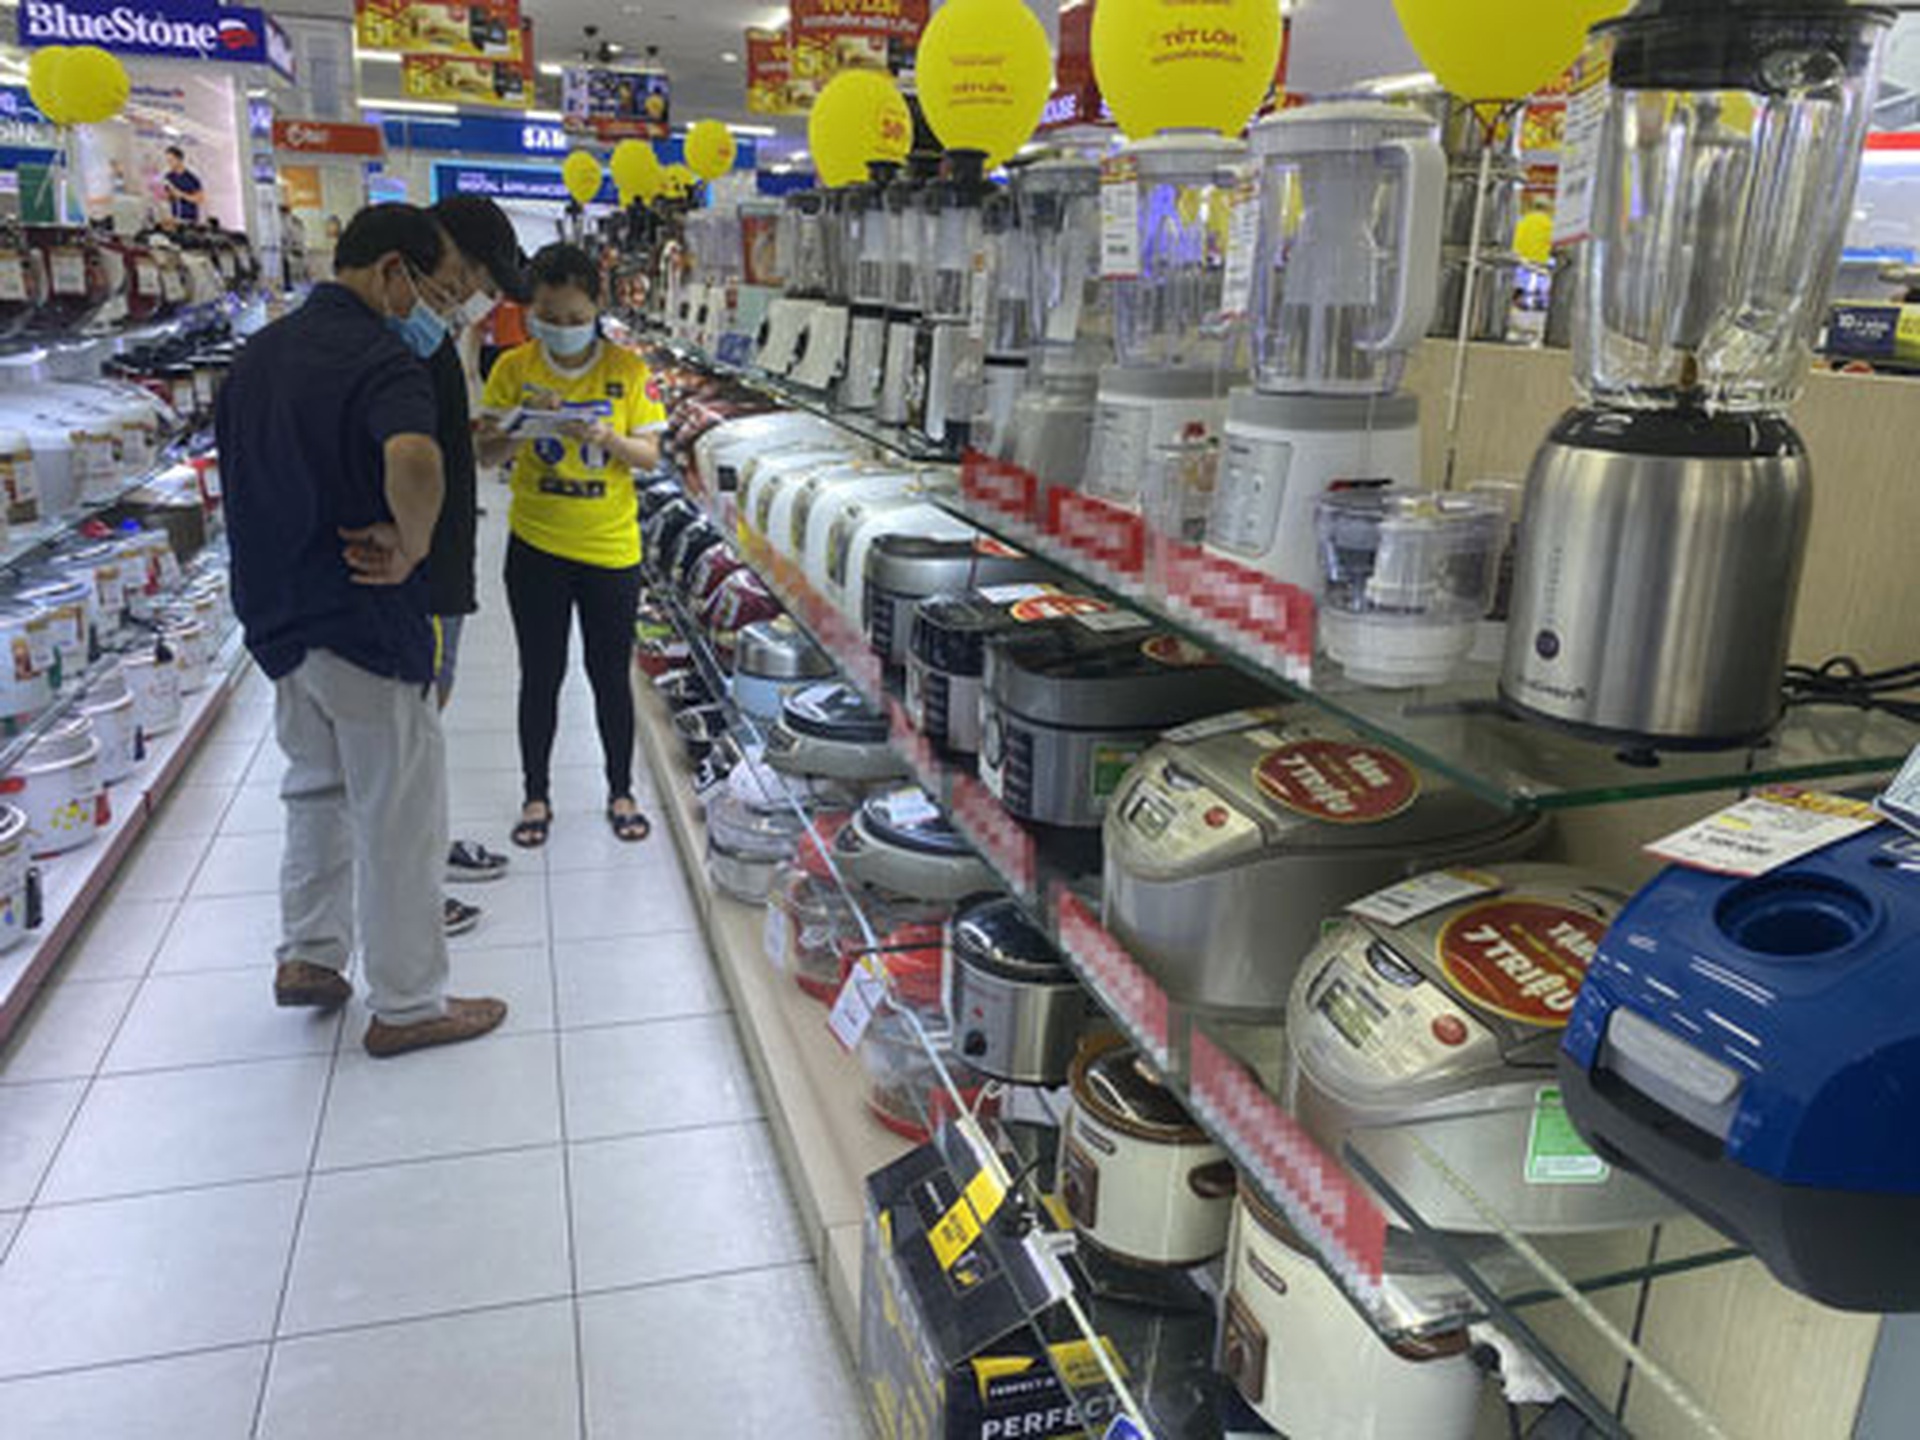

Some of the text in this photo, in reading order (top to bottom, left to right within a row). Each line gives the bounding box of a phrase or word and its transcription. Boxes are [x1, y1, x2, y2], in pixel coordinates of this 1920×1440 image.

[26, 3, 217, 49] BlueStone
[1462, 923, 1500, 943] 7
[1484, 939, 1577, 1012] TRIỆU
[981, 1394, 1118, 1440] PERFECT
